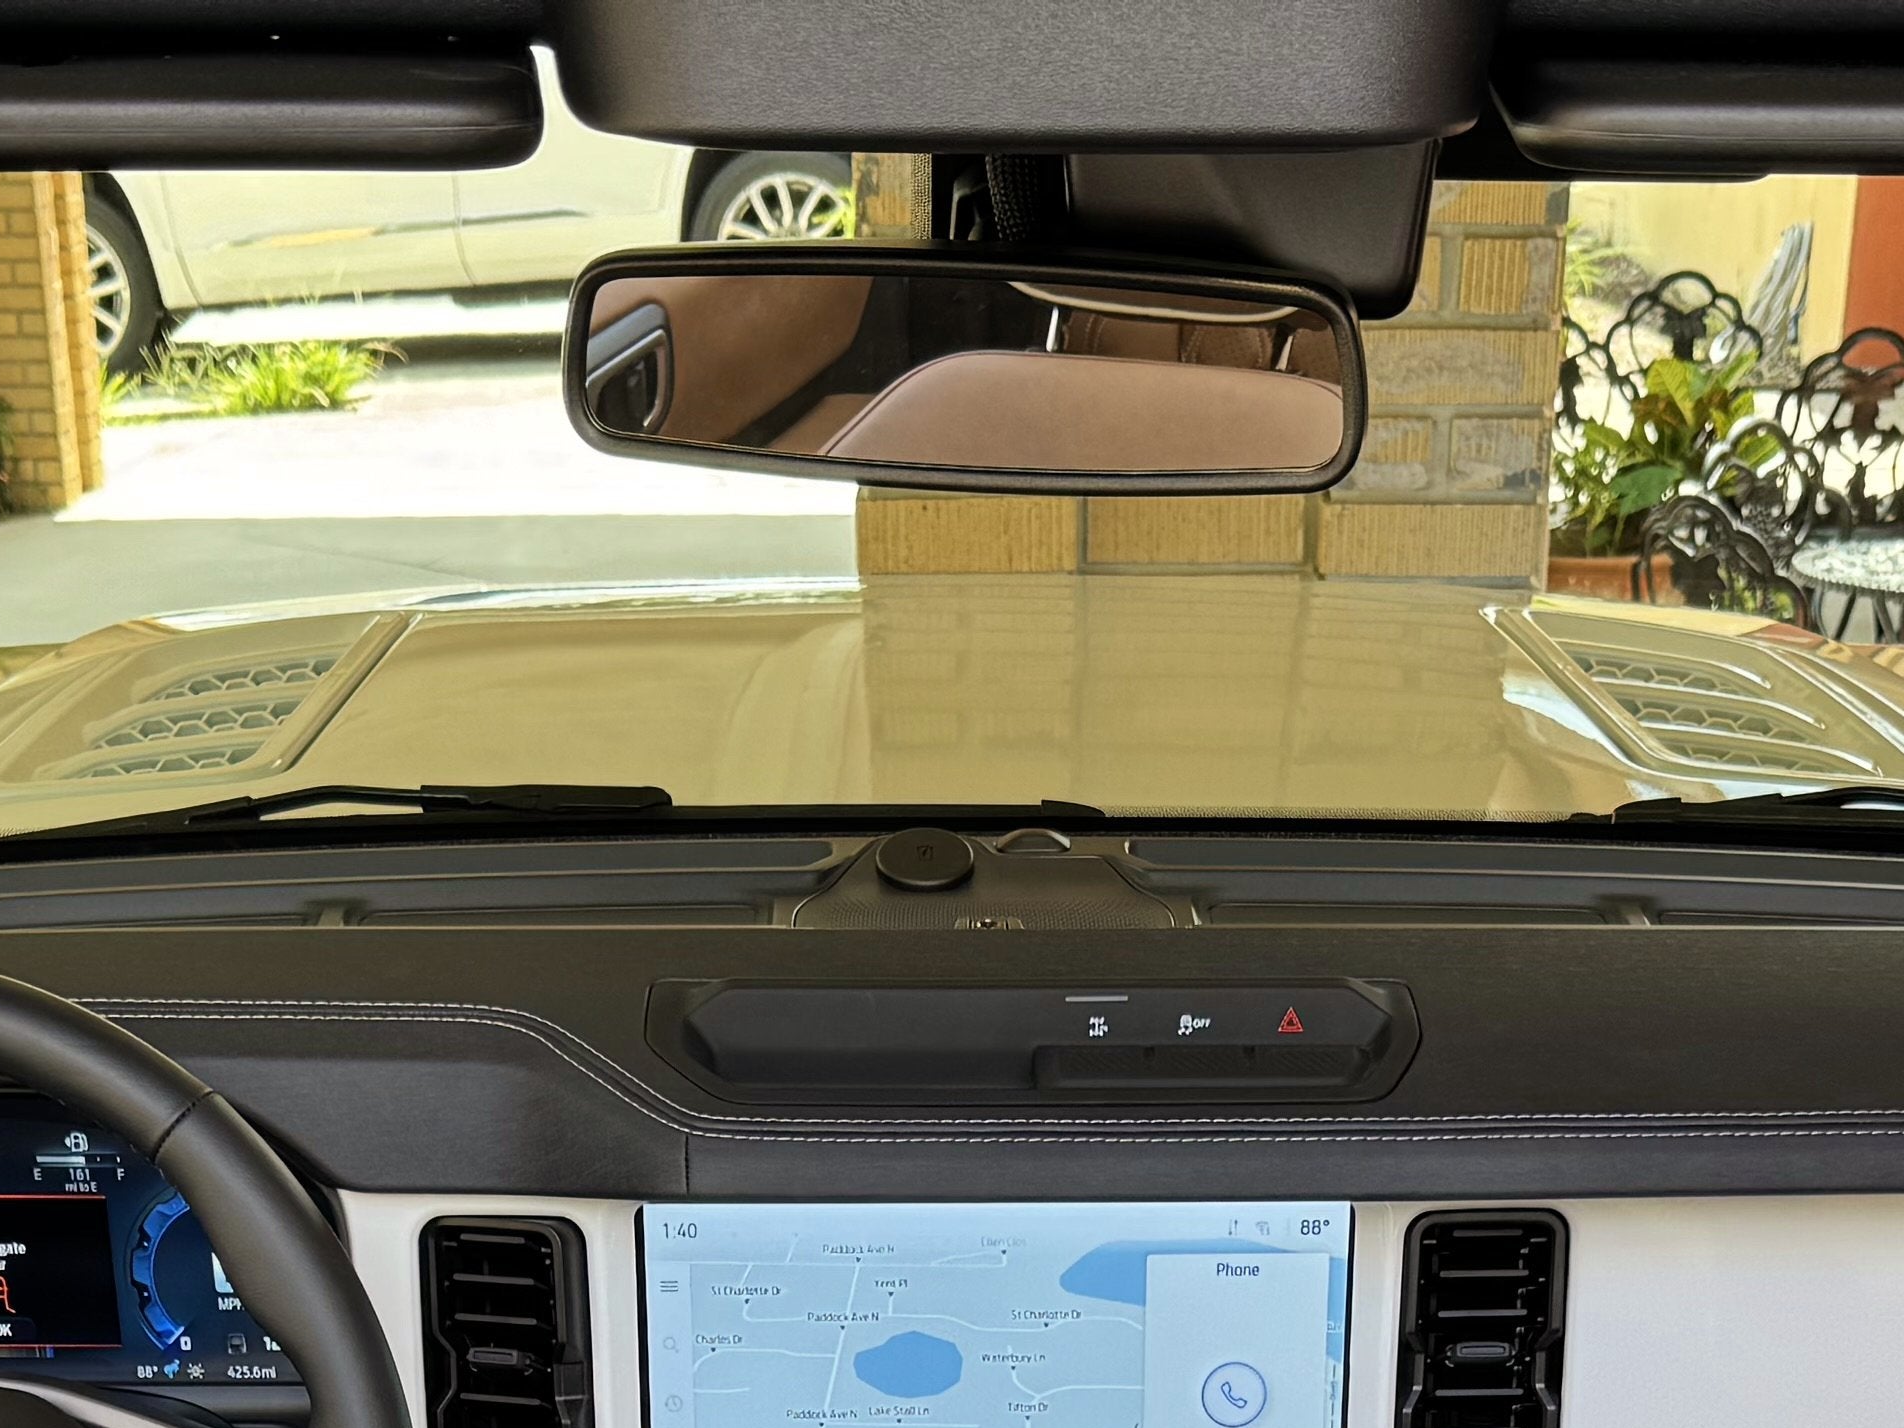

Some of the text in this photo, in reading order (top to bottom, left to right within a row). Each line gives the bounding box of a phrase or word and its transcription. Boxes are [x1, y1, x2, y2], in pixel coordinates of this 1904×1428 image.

[33, 1168, 42, 1181] E
[69, 1168, 90, 1181] 161
[117, 1168, 125, 1181] F
[663, 1222, 698, 1239] 1:40
[1300, 1219, 1331, 1236] 88°
[1216, 1263, 1260, 1277] Phone
[807, 1312, 879, 1322] Paddock Ave N
[180, 1336, 192, 1351] 0
